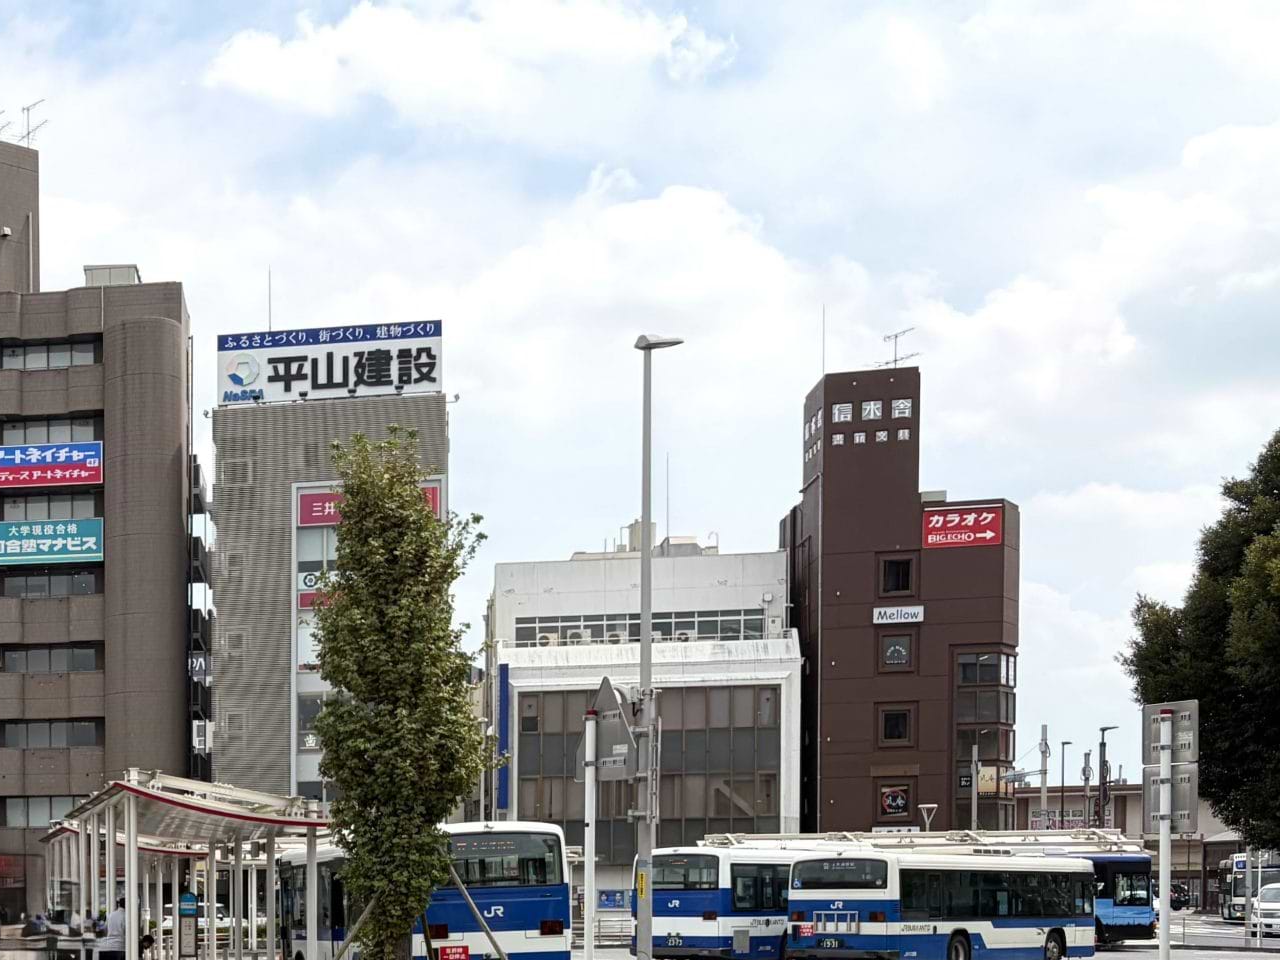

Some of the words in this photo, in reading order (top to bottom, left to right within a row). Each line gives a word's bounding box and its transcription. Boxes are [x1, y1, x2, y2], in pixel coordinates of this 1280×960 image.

[267, 347, 438, 393] 平山建設
[32, 469, 96, 480] アートネイチャー
[928, 511, 996, 528] カラオケ
[8, 523, 78, 536] 大学現役合格
[927, 533, 947, 543] BIG
[948, 532, 974, 541] ECHO
[876, 608, 920, 621] Mellow
[668, 900, 680, 908] JR
[830, 901, 843, 909] JR
[483, 905, 504, 918] JR
